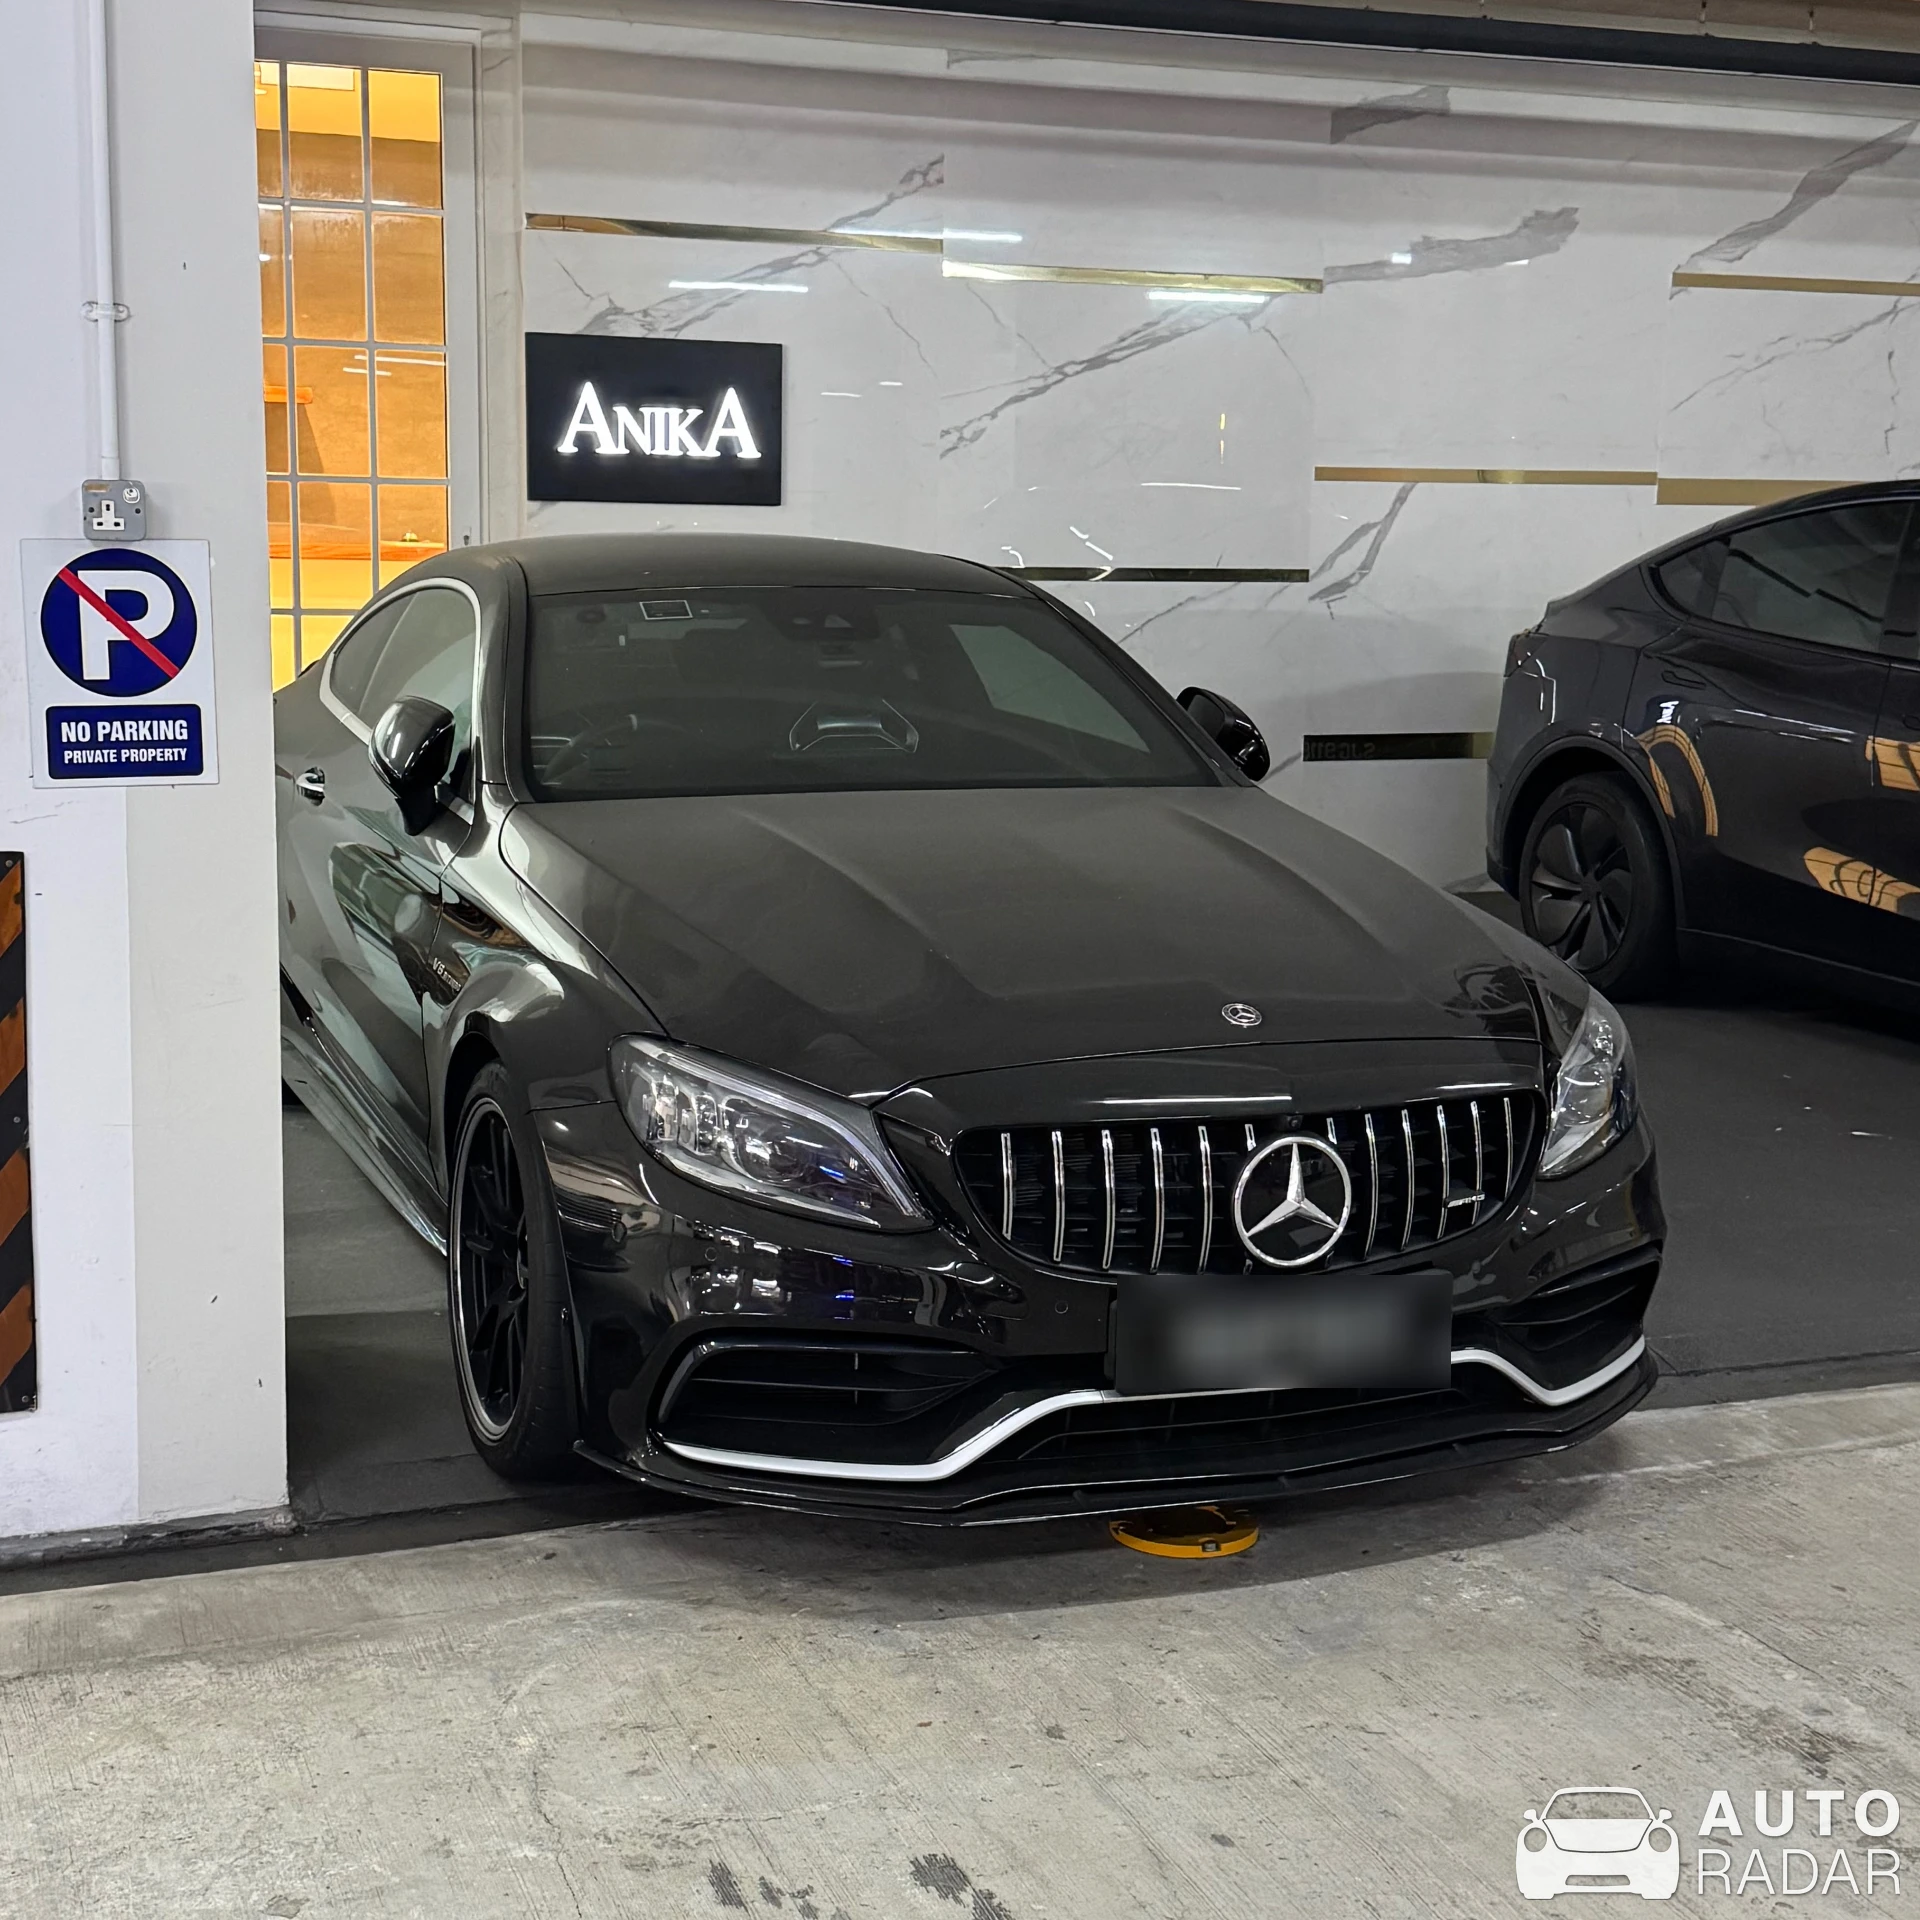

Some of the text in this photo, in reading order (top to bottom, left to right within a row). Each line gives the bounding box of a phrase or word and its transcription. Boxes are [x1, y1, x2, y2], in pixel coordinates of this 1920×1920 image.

[556, 380, 762, 459] ANIKA
[77, 570, 175, 681] P
[61, 719, 188, 743] NO PARKING
[64, 747, 187, 764] PRIVATE PROPERTY
